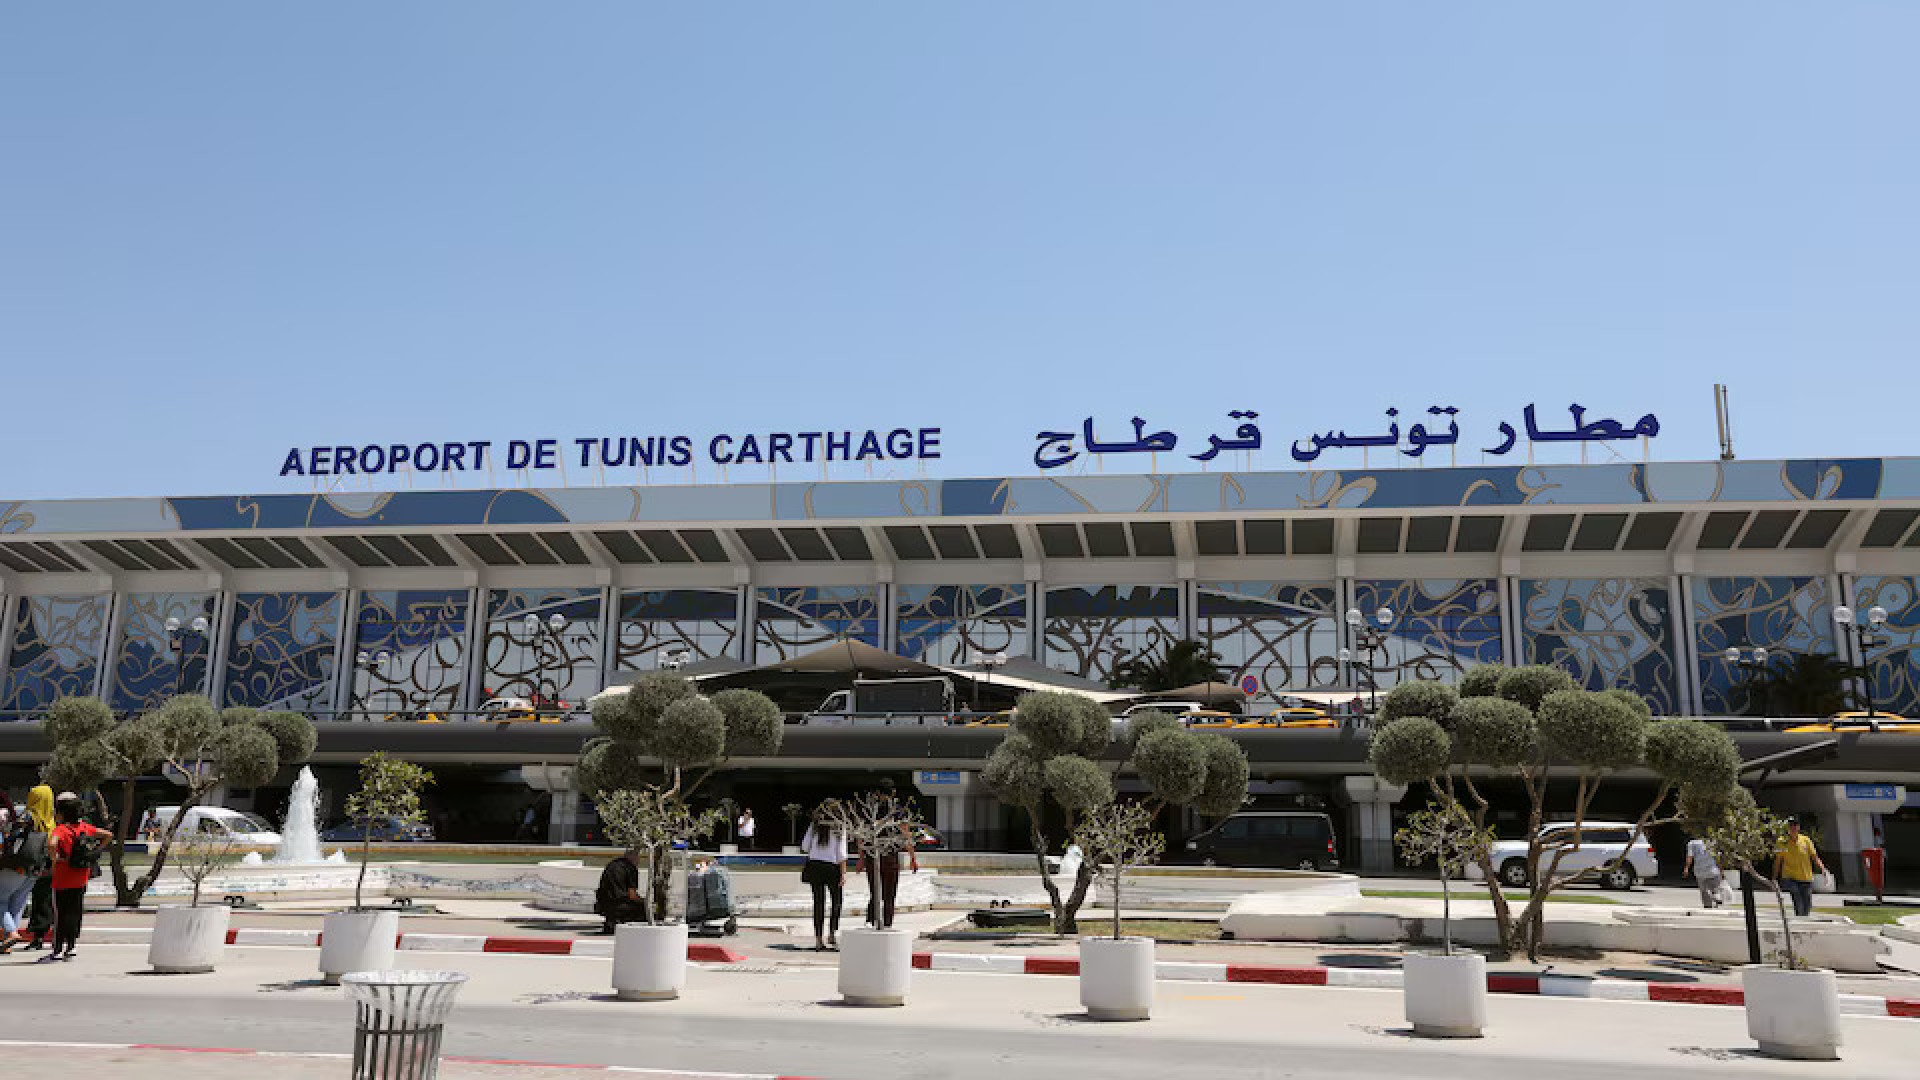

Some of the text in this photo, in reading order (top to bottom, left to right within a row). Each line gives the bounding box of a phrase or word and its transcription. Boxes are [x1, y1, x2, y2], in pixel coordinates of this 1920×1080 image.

[280, 427, 941, 476] AEROPORT DE TUNIS CARTHAGE
[1291, 405, 1460, 463] تونس
[1482, 403, 1661, 455] مطار
